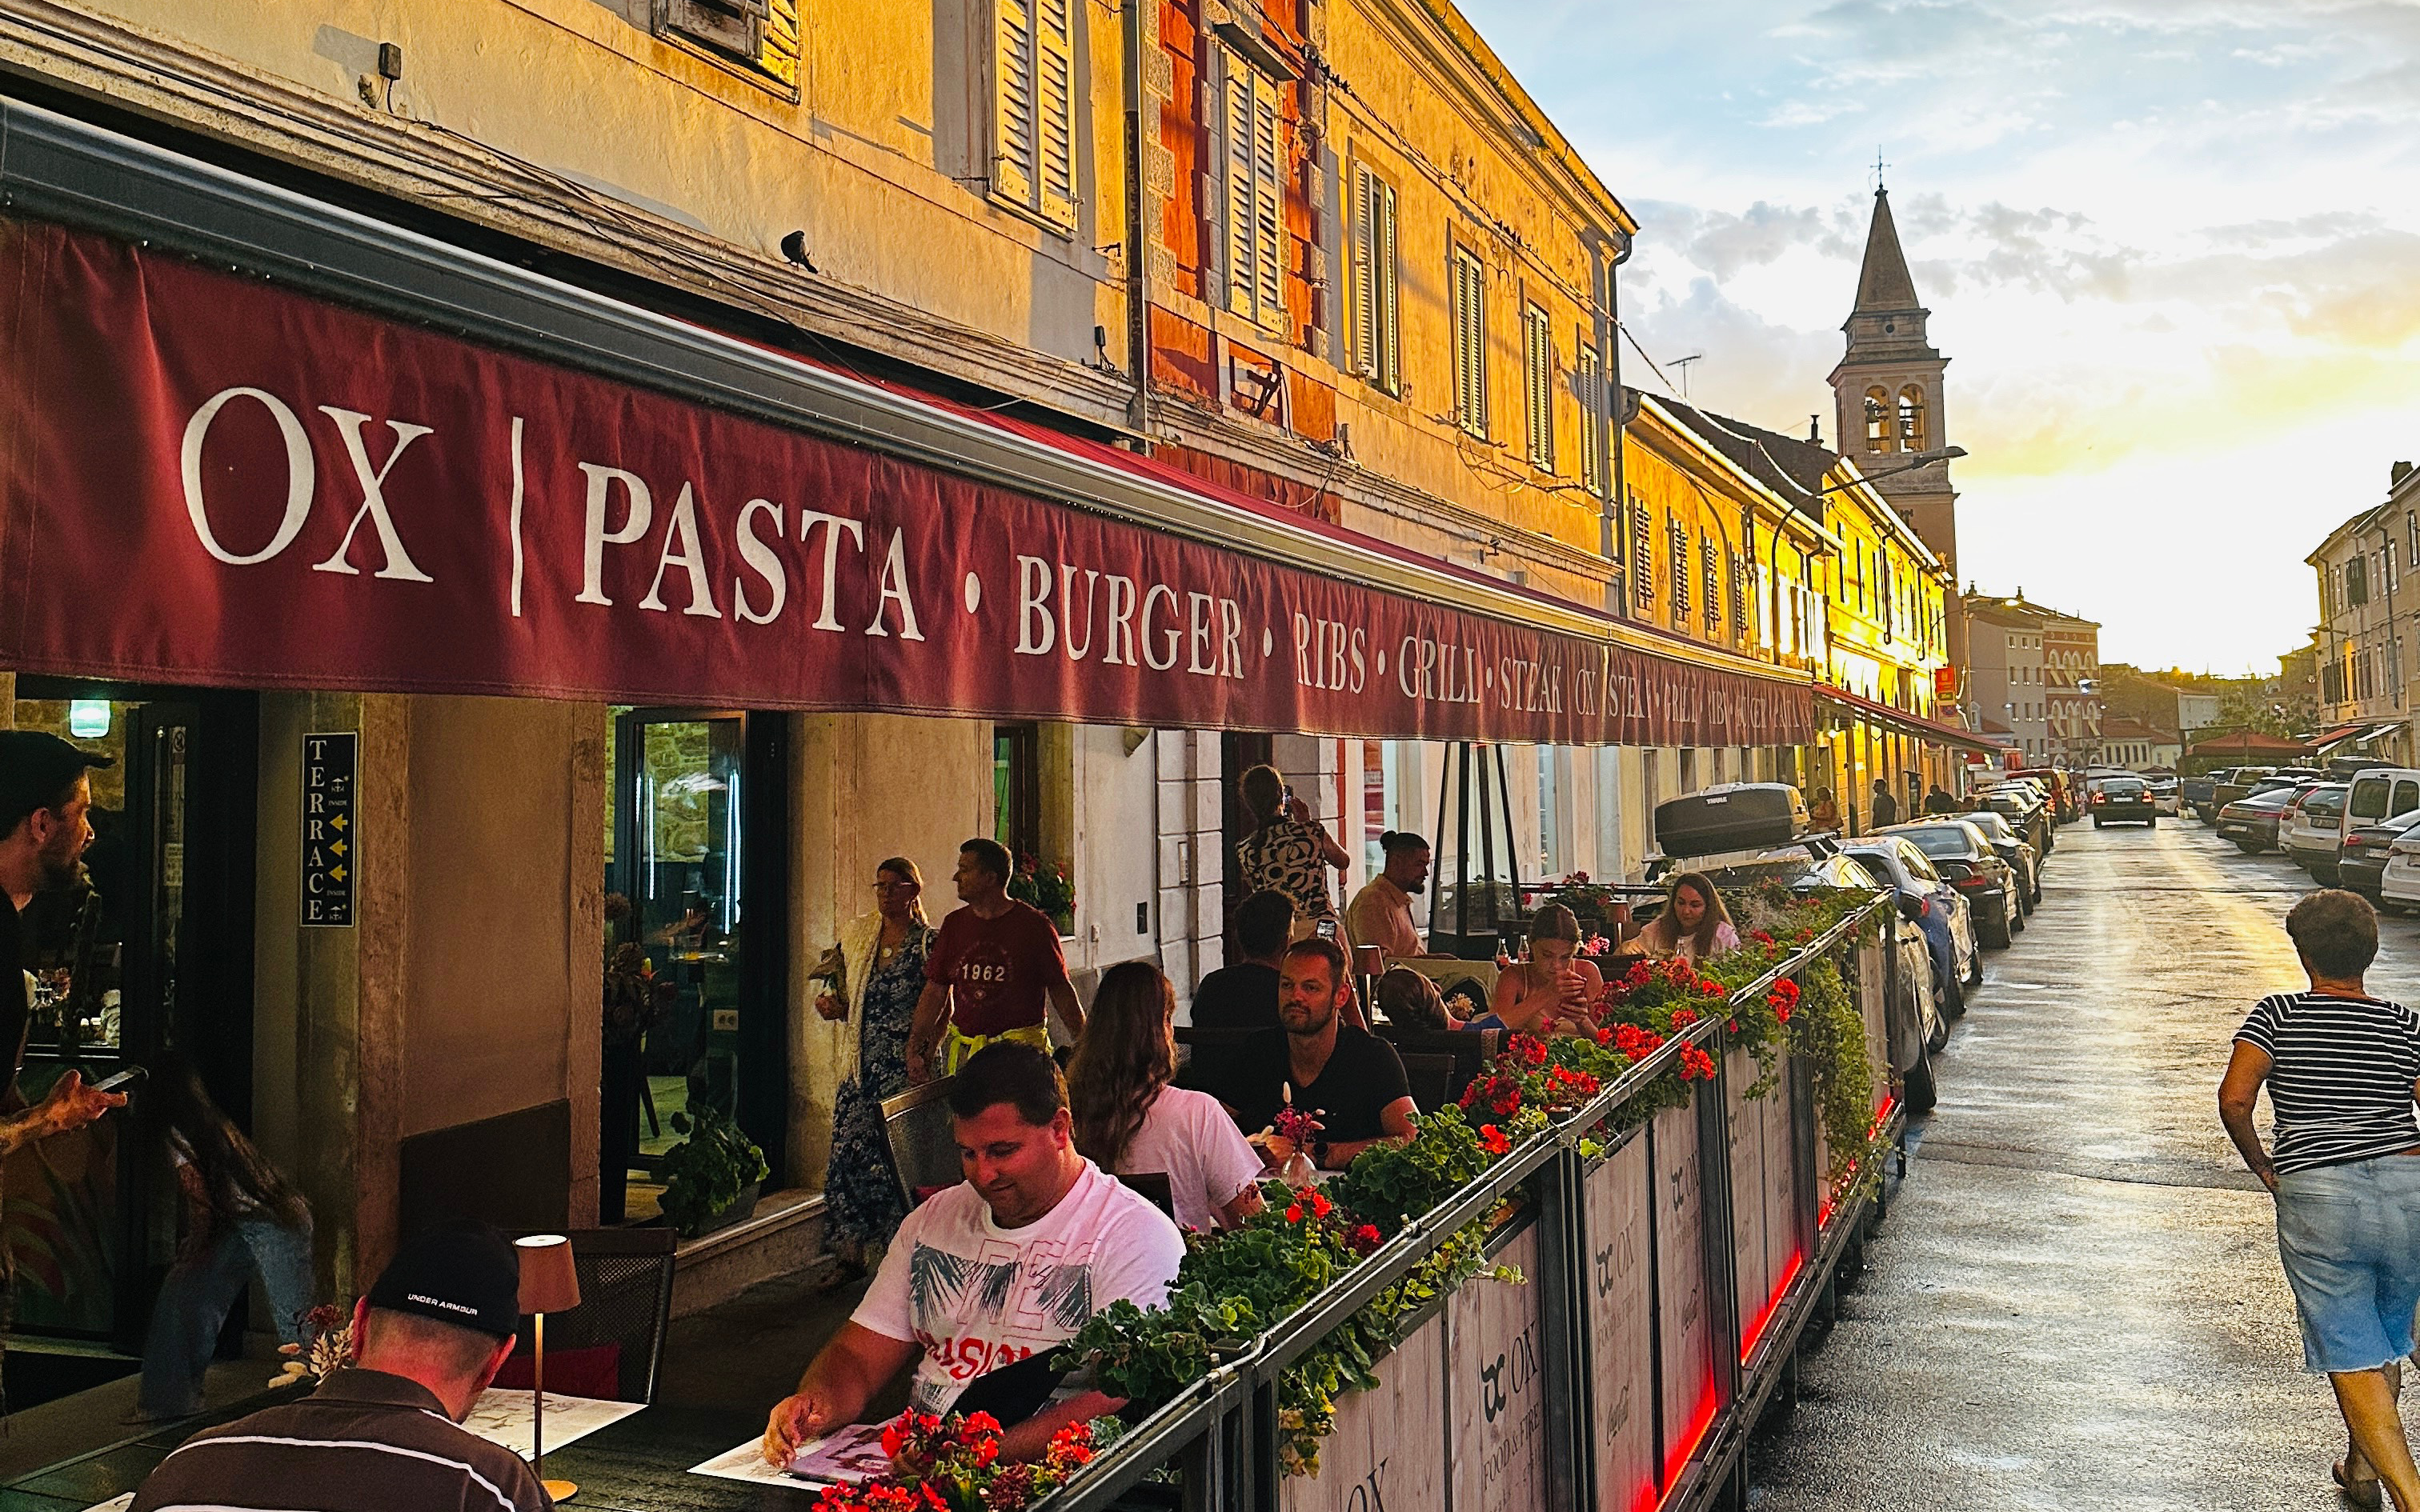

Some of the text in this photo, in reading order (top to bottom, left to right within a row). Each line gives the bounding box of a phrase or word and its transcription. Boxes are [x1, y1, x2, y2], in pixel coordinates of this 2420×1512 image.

[181, 386, 1562, 714] OX PASTA BURGER RIBS GRILL STEAK
[1575, 668, 1597, 716] OX
[308, 740, 327, 921] TERRACE
[962, 963, 1005, 982] 1962
[407, 1294, 478, 1316] UNDER ARMOUR
[1512, 1320, 1538, 1394] OX
[1483, 1438, 1509, 1491] FOOD
[1520, 1402, 1540, 1448] FIRE
